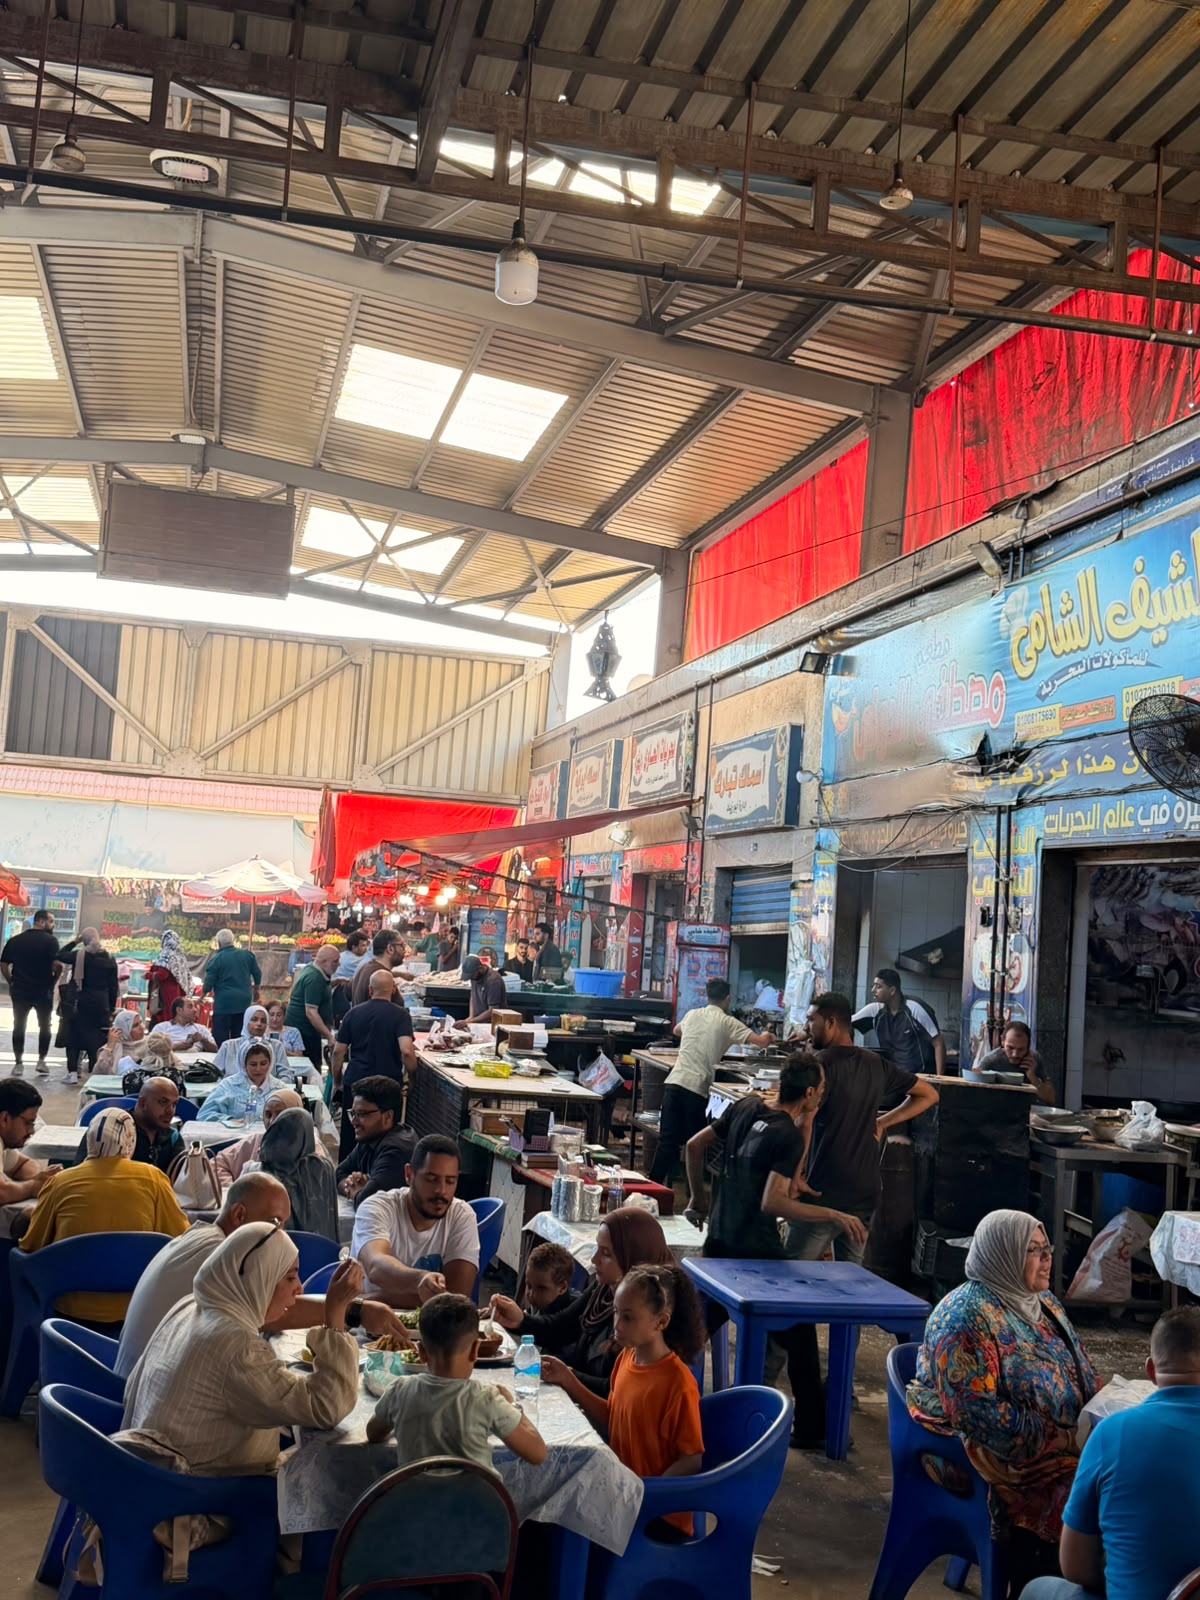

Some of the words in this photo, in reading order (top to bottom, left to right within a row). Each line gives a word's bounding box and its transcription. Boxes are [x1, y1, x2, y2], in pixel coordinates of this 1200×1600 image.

[738, 754, 766, 789] أسماك
[1077, 751, 1116, 776] هذا
[1044, 802, 1101, 840] البحريات
[1103, 800, 1135, 836] عالم
[1137, 795, 1171, 832] في
